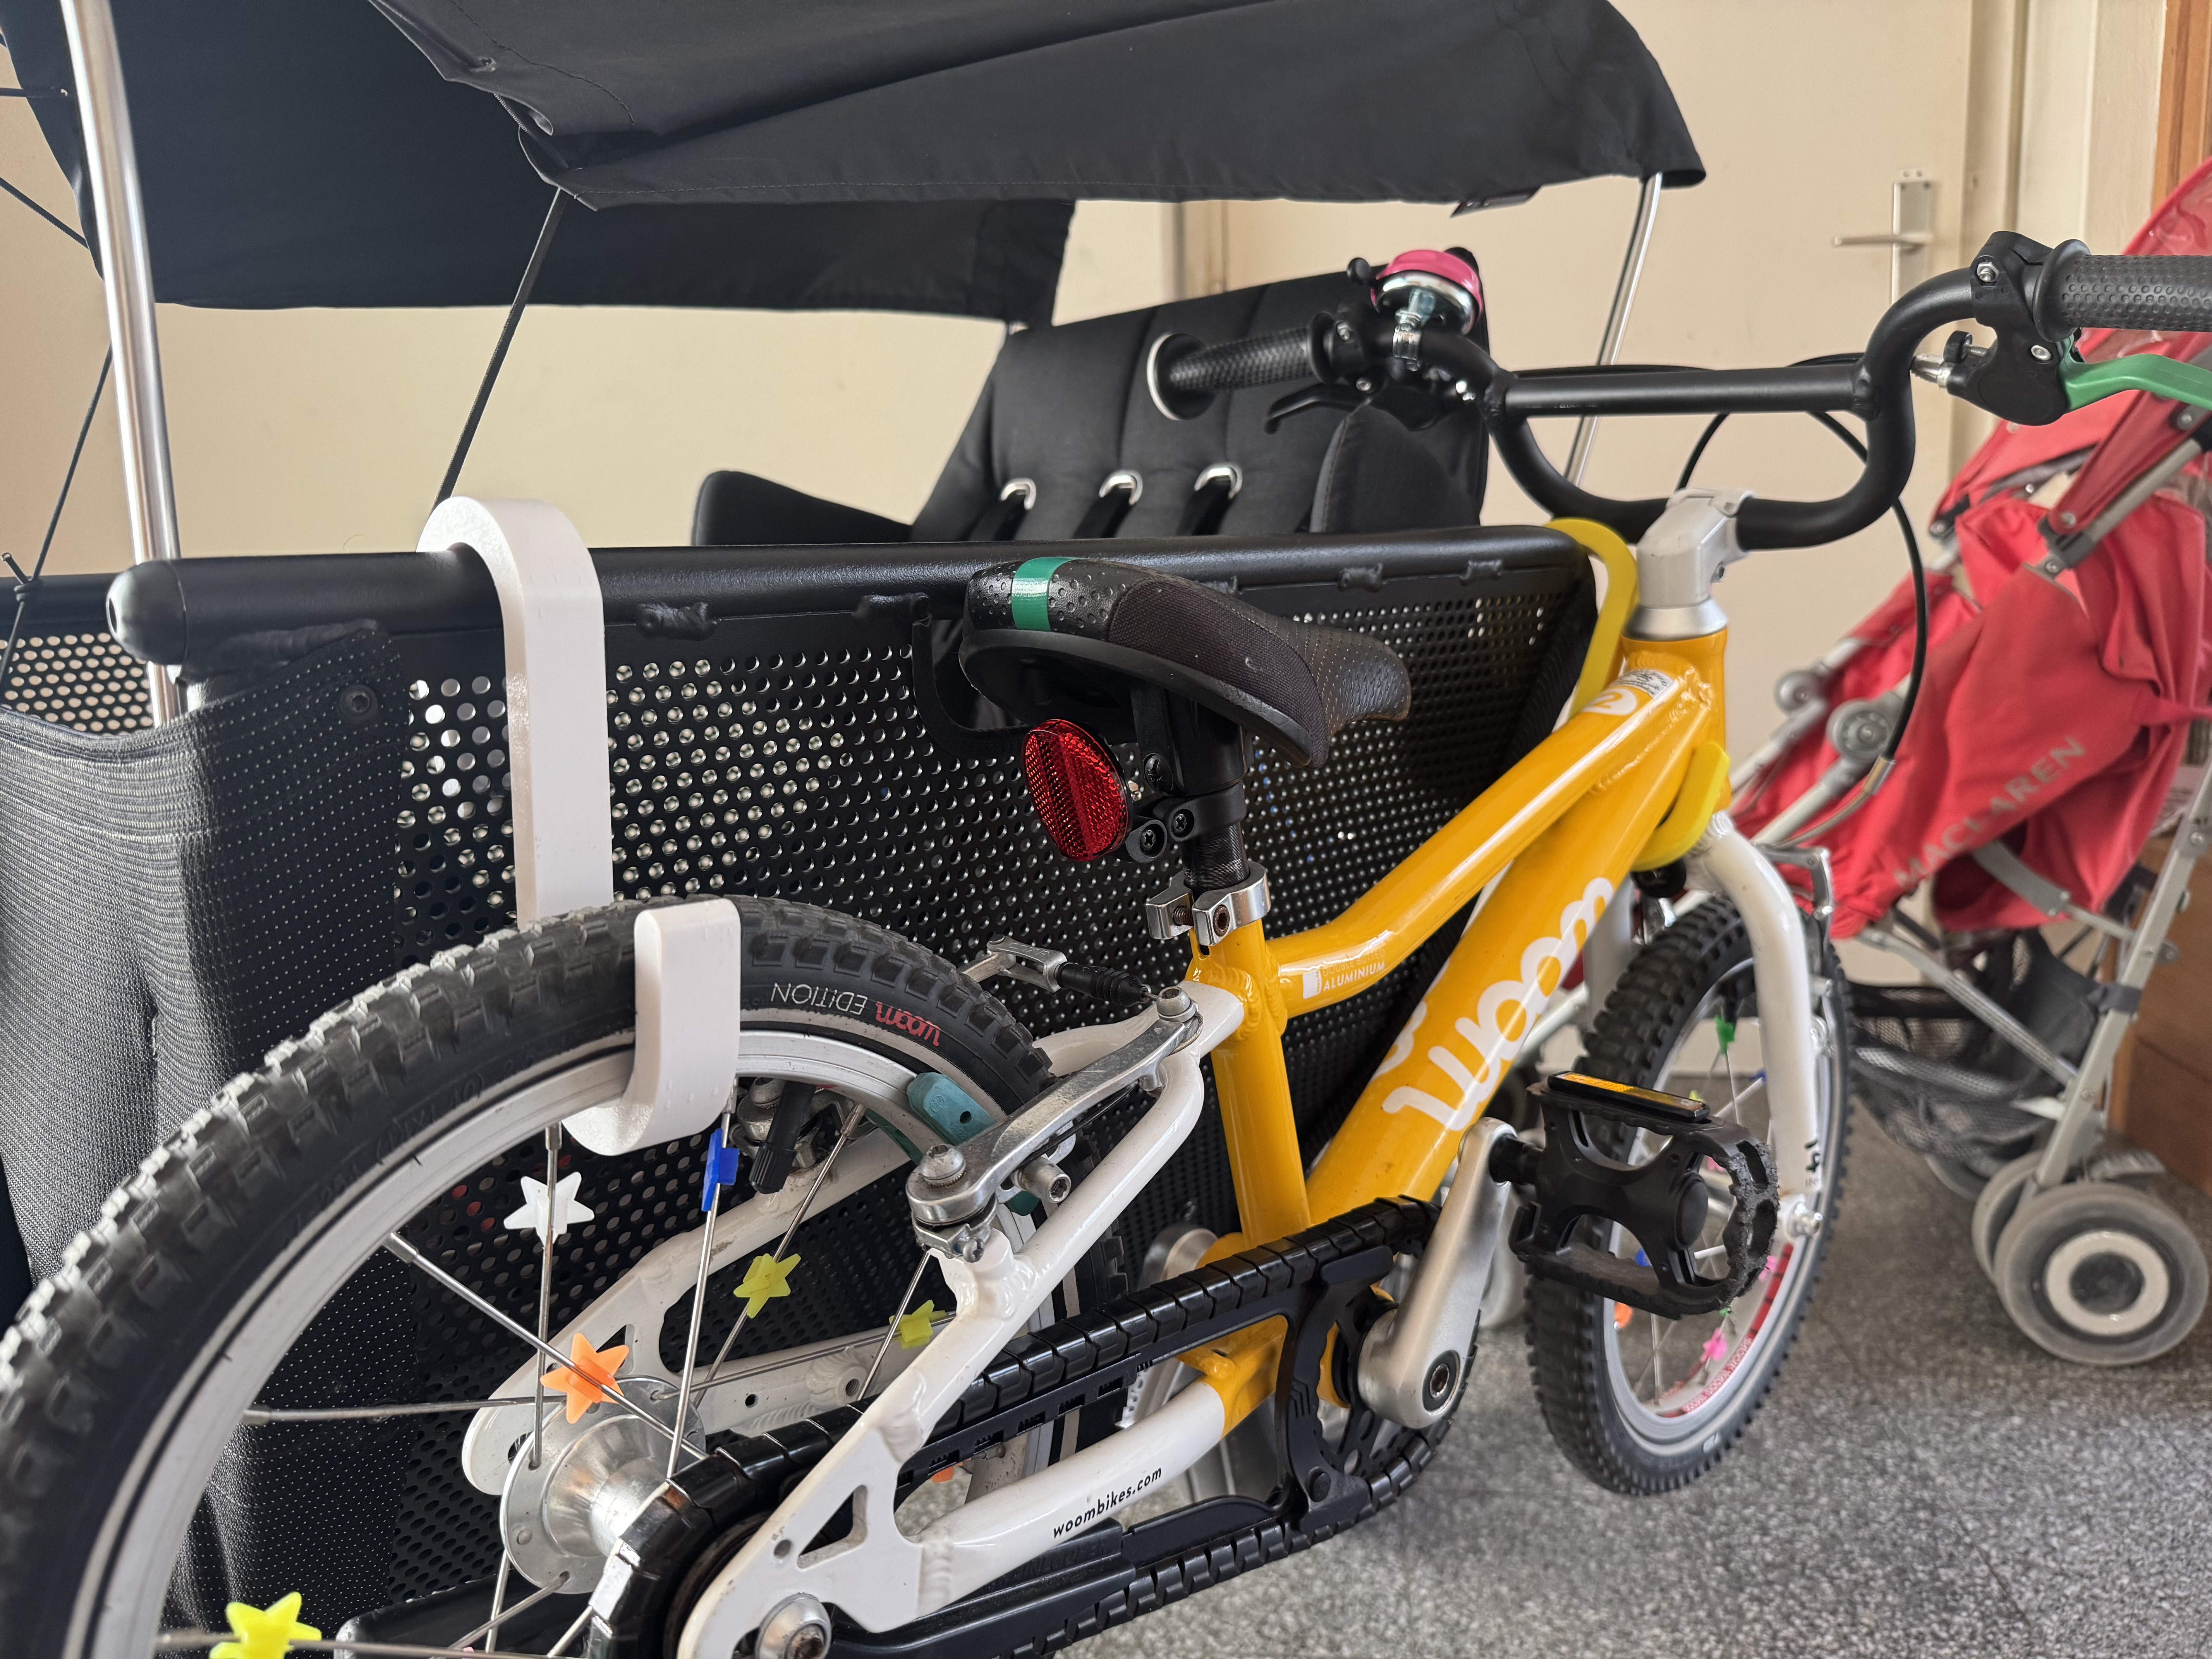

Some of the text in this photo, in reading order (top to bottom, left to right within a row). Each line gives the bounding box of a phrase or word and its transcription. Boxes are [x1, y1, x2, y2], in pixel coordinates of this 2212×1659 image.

[1323, 961, 1385, 992] ALUMINIUM
[1382, 877, 1614, 1132] woom
[771, 982, 940, 1046] woom EDITION
[1053, 1467, 1162, 1539] woombikes.com
